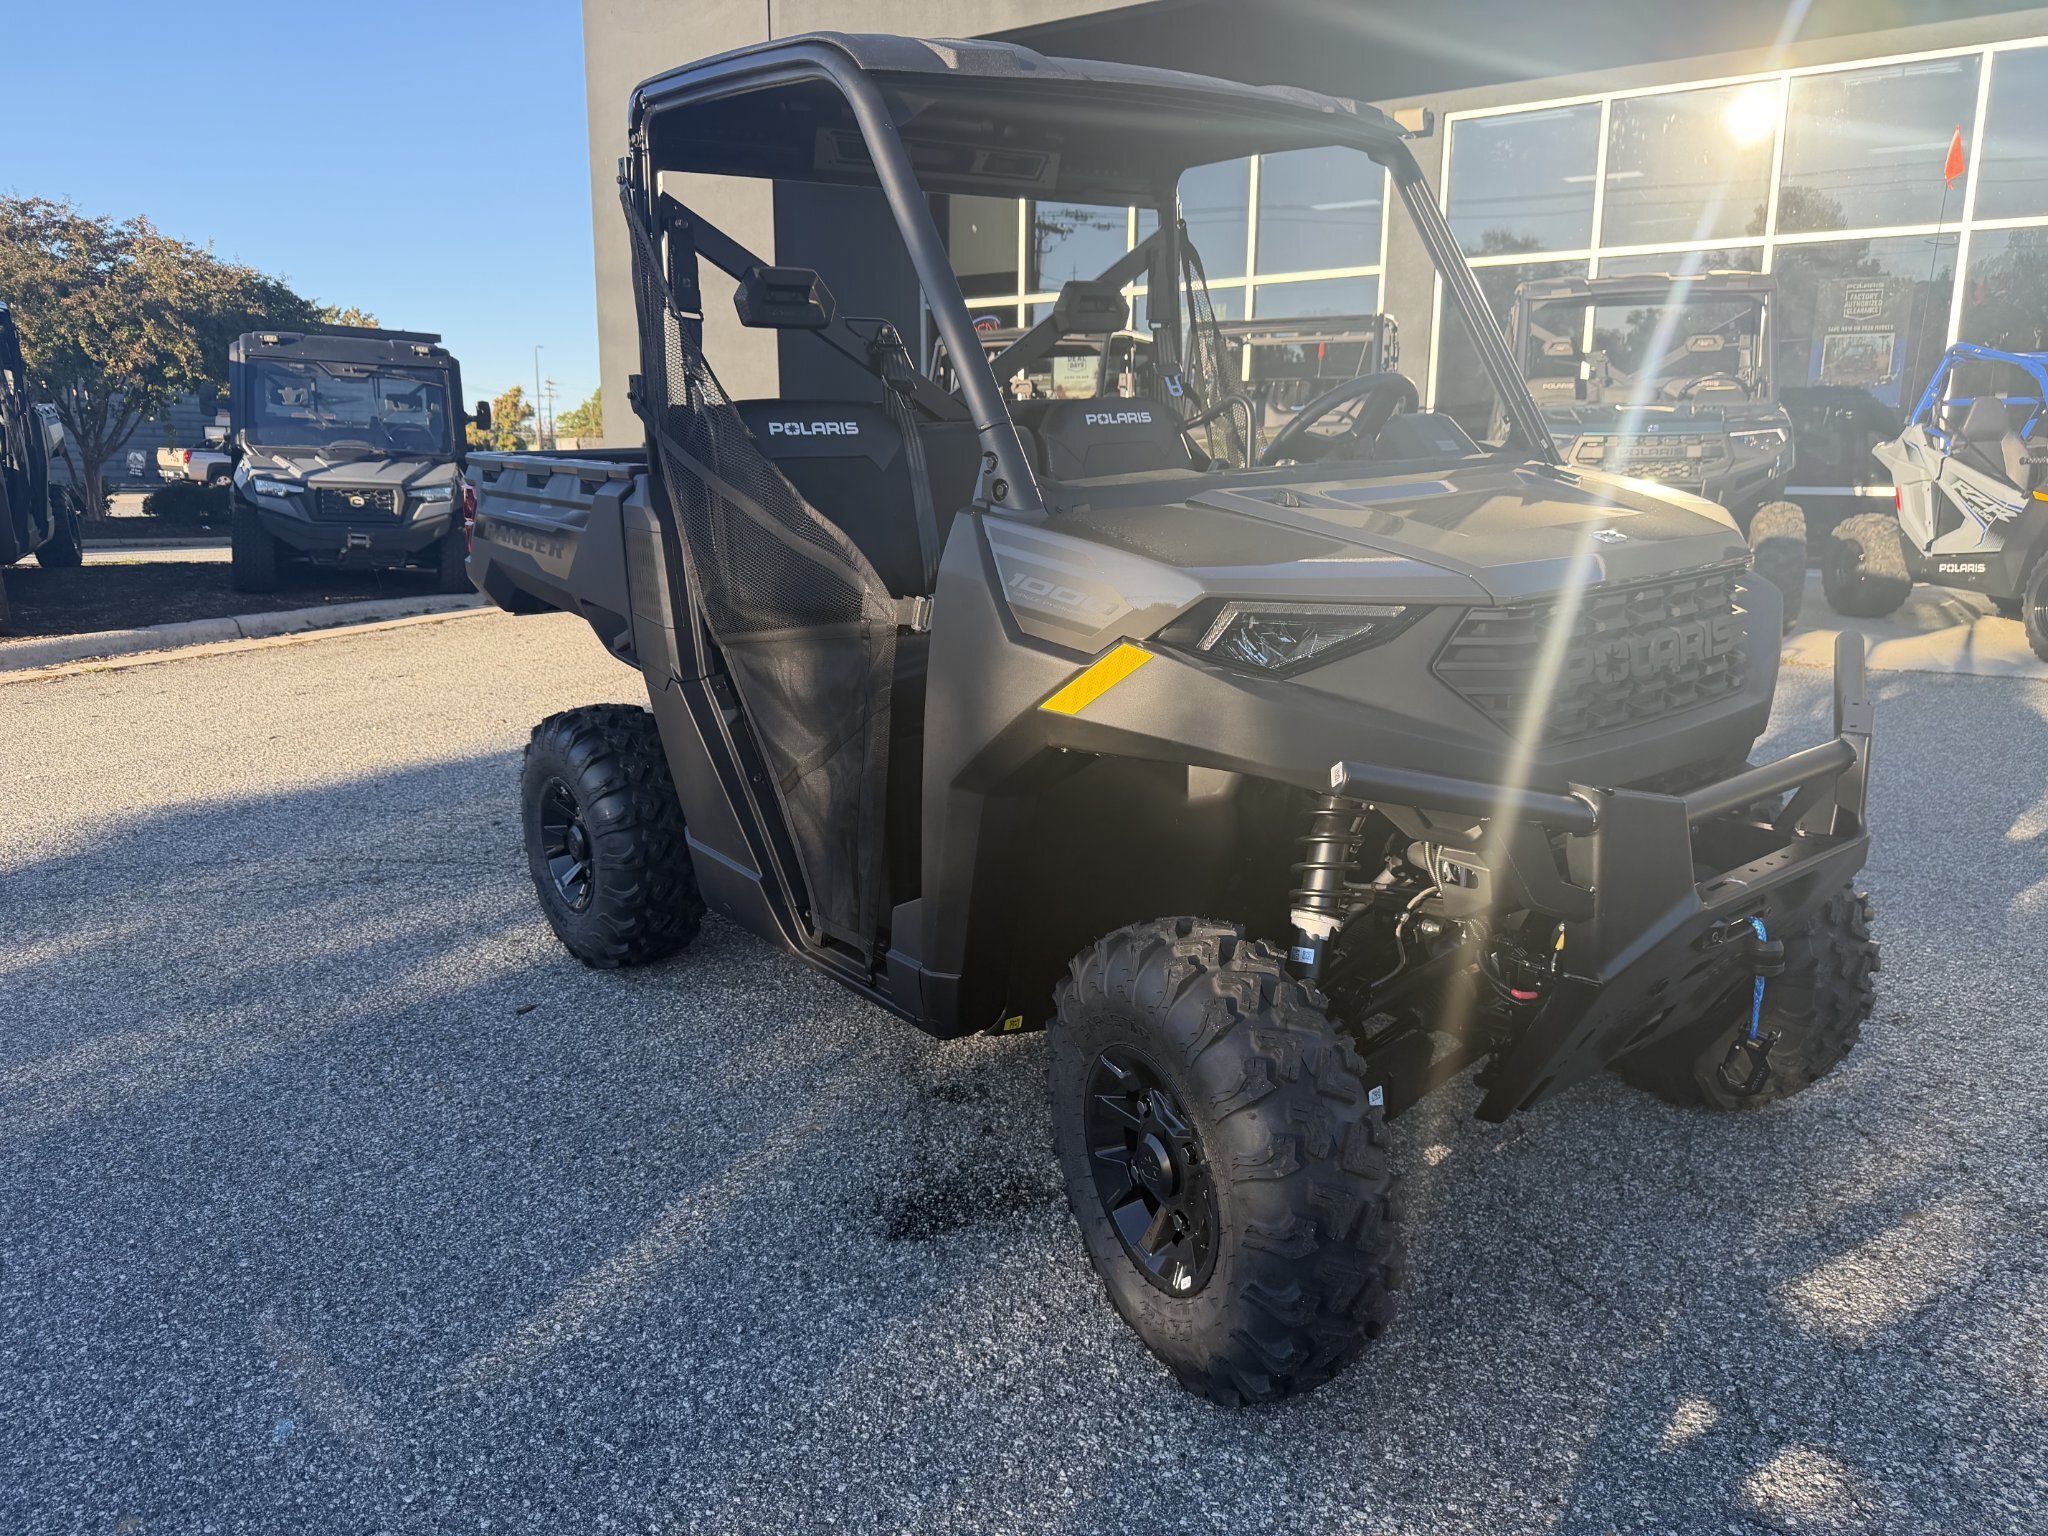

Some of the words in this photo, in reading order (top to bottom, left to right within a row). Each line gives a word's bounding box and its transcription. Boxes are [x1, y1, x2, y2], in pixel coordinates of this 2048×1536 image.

[1845, 300, 1883, 308] AUTHORIZED
[1846, 307, 1879, 315] CLEARANCE
[1084, 411, 1152, 425] POLARIS
[768, 421, 859, 435] POLARIS
[1950, 480, 2018, 523] RZR
[483, 520, 565, 559] RANGER
[1938, 563, 1986, 573] POLARIS
[1555, 614, 1739, 690] POLARIS
